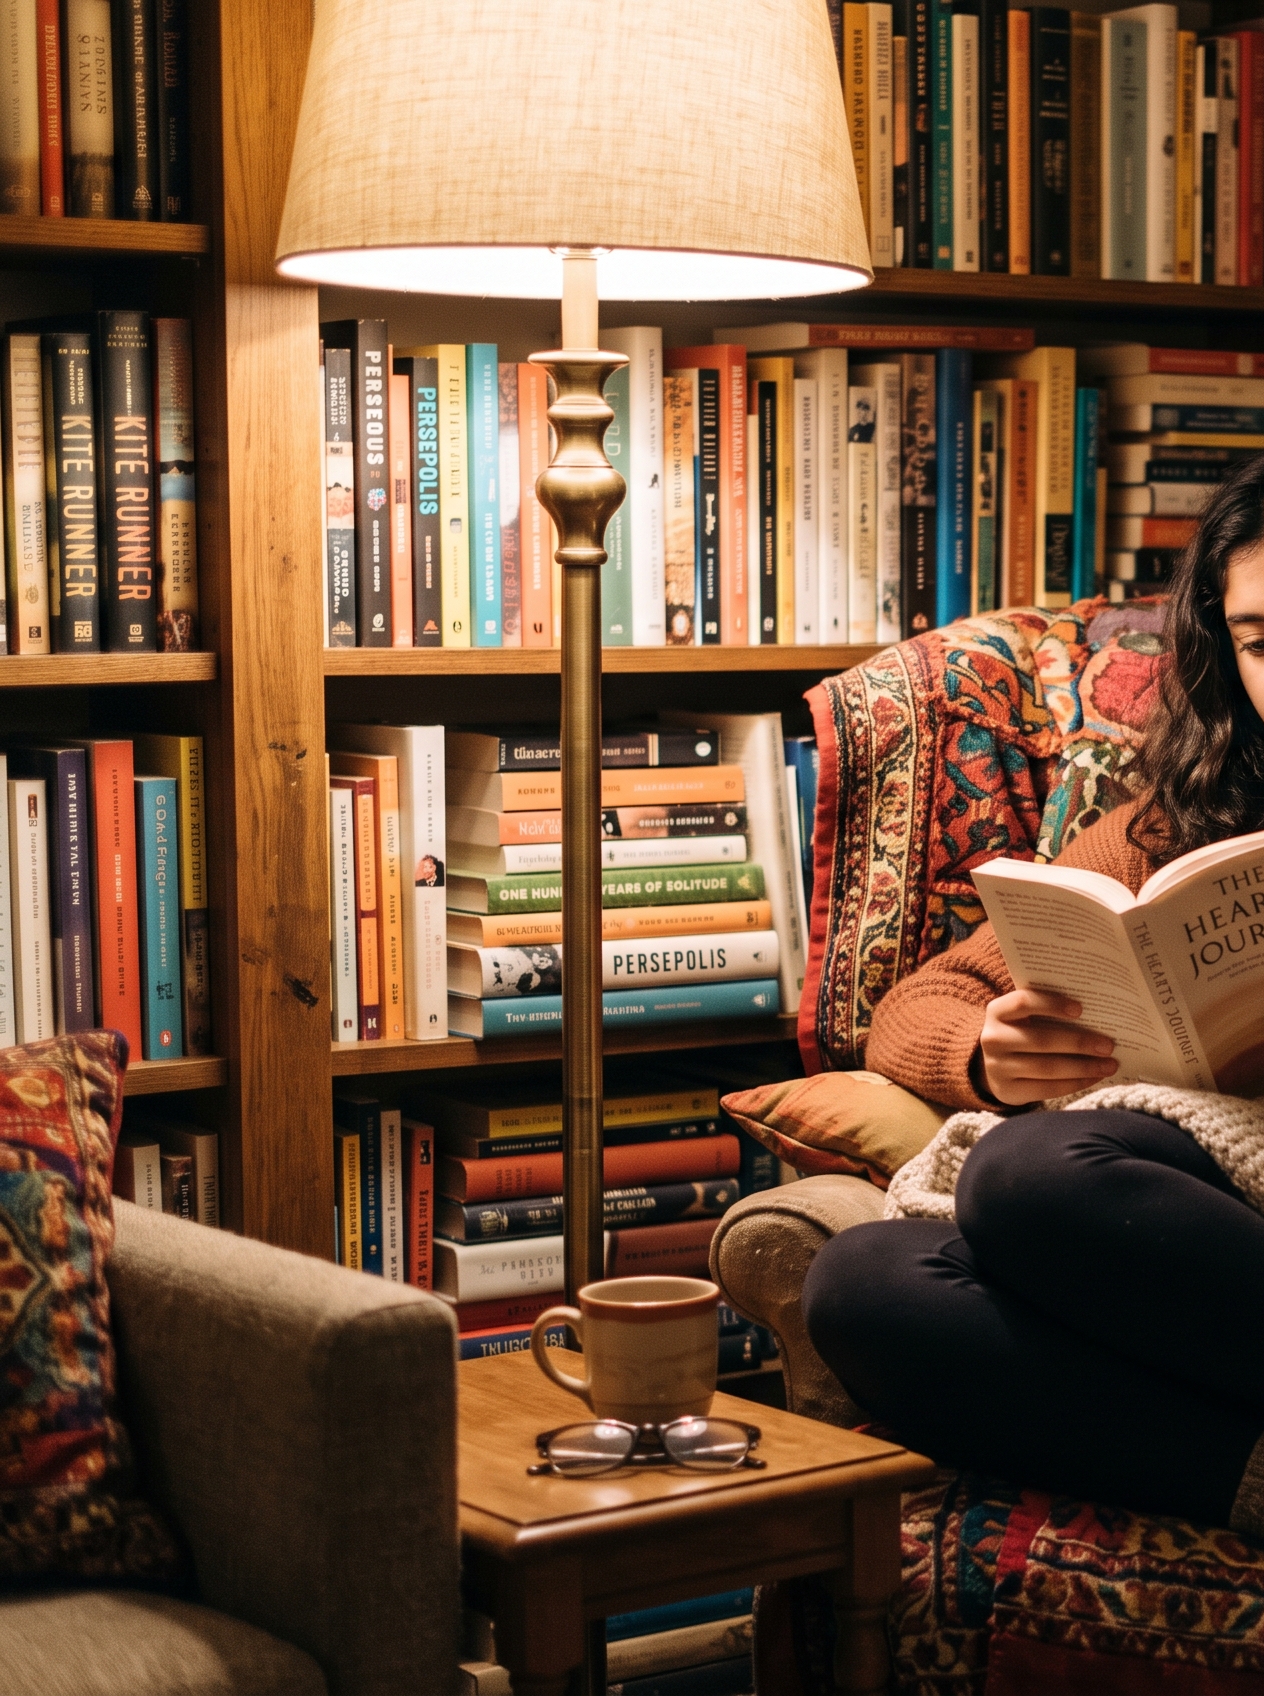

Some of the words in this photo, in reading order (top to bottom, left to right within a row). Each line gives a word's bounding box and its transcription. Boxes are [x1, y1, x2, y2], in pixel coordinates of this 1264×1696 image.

[365, 350, 384, 466] PERSEOUS
[61, 415, 93, 477] KITE
[114, 416, 149, 475] KITE
[416, 386, 439, 516] PERSEPOLIS
[63, 485, 97, 598] RUNNER
[115, 487, 152, 601] RUNNER
[499, 888, 527, 901] ONE
[645, 880, 662, 893] OF
[666, 877, 728, 891] SOLITUDE
[613, 949, 727, 975] PERSEPOLIS
[1133, 920, 1153, 951] THE
